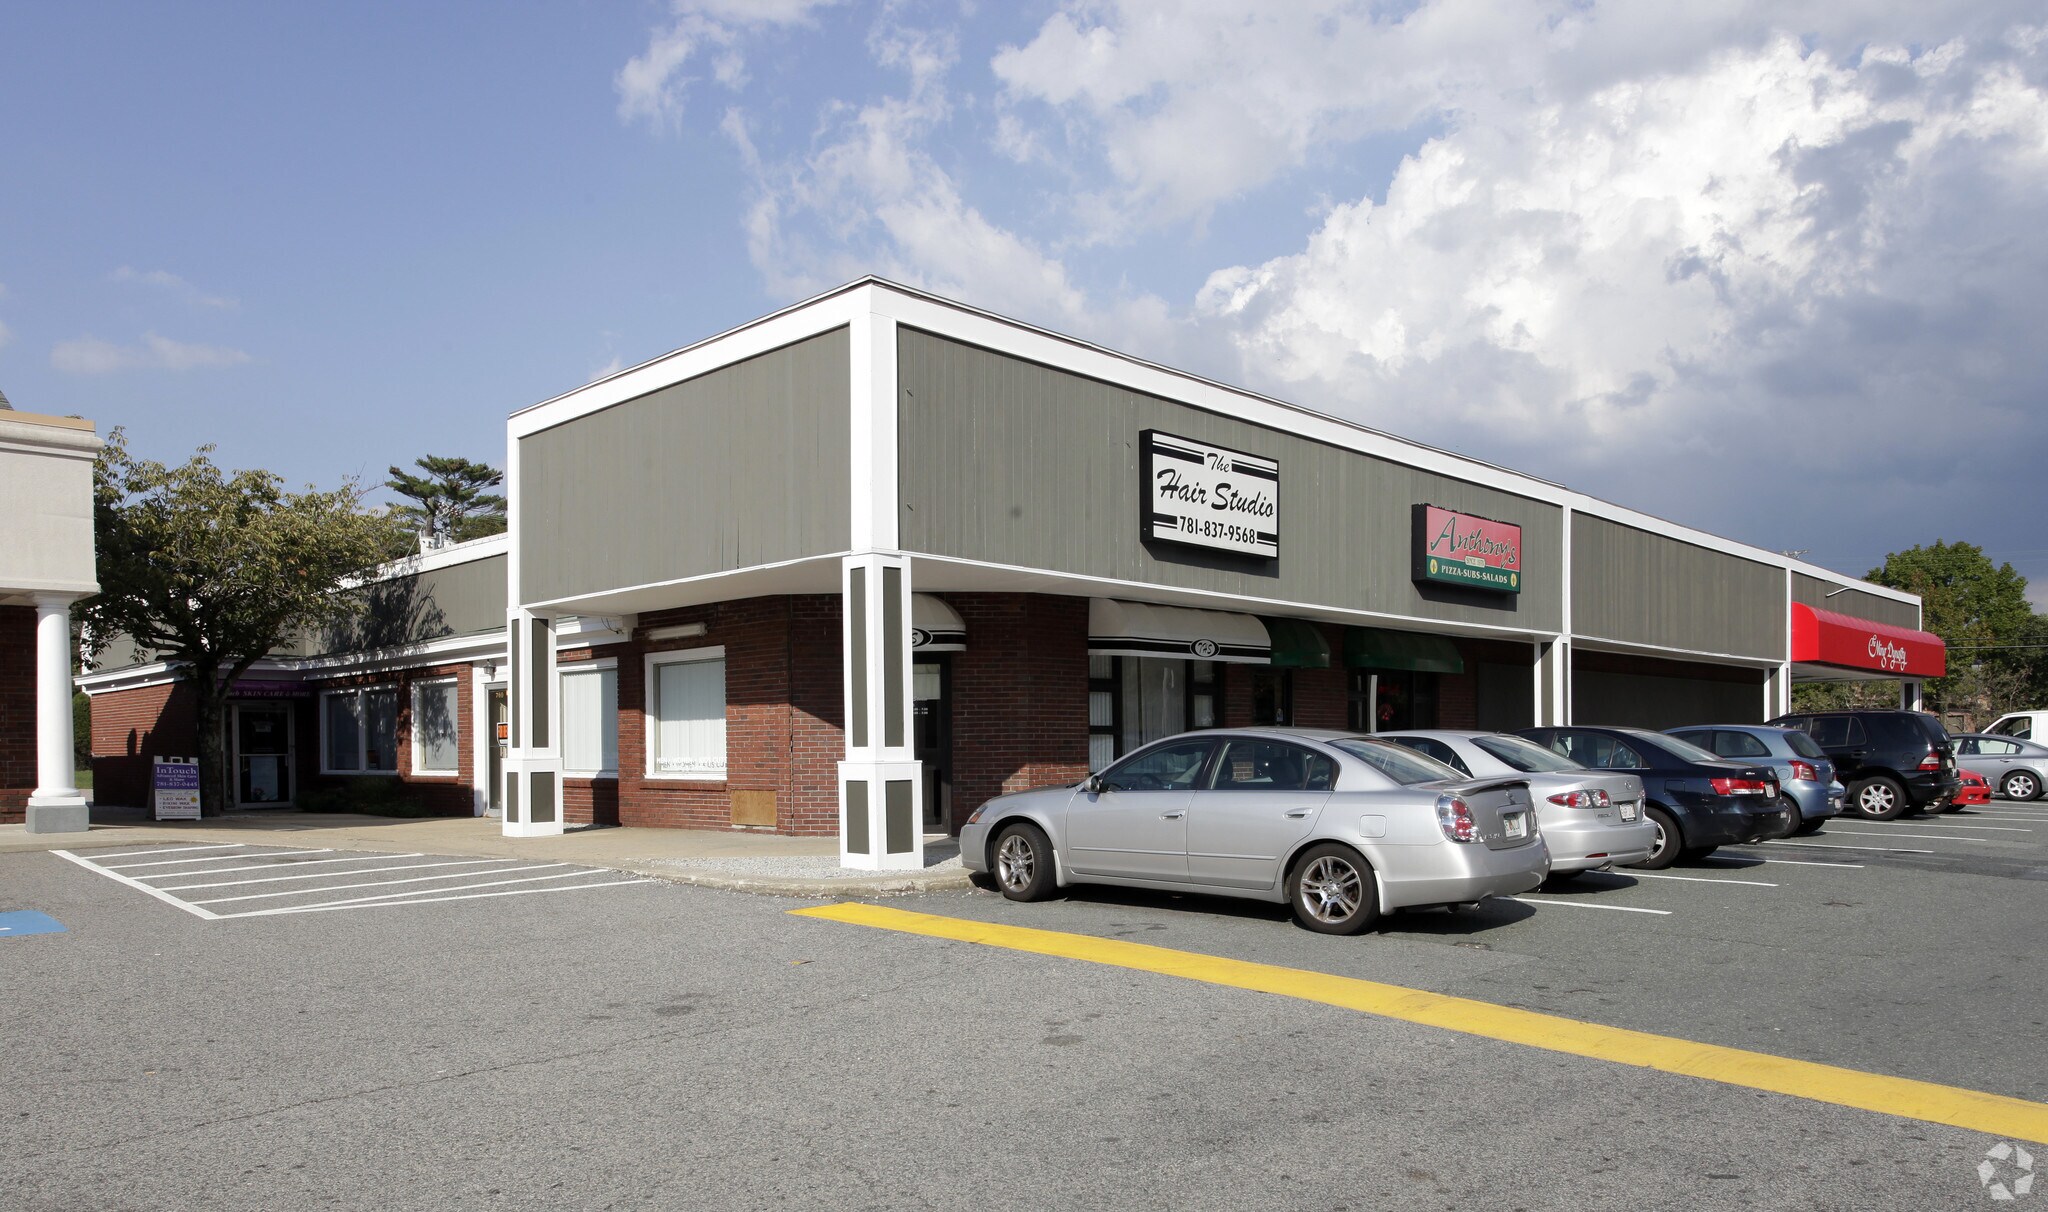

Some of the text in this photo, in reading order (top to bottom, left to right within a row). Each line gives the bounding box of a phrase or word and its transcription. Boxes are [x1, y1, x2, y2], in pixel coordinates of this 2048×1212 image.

[1207, 452, 1230, 473] The
[1156, 468, 1274, 518] Hair Studio
[1179, 515, 1256, 545] 781-837-9568
[1430, 516, 1516, 569] Anthony's
[1441, 565, 1508, 584] PIZZA-SUBS-SALADS
[156, 766, 197, 775] InTouch
